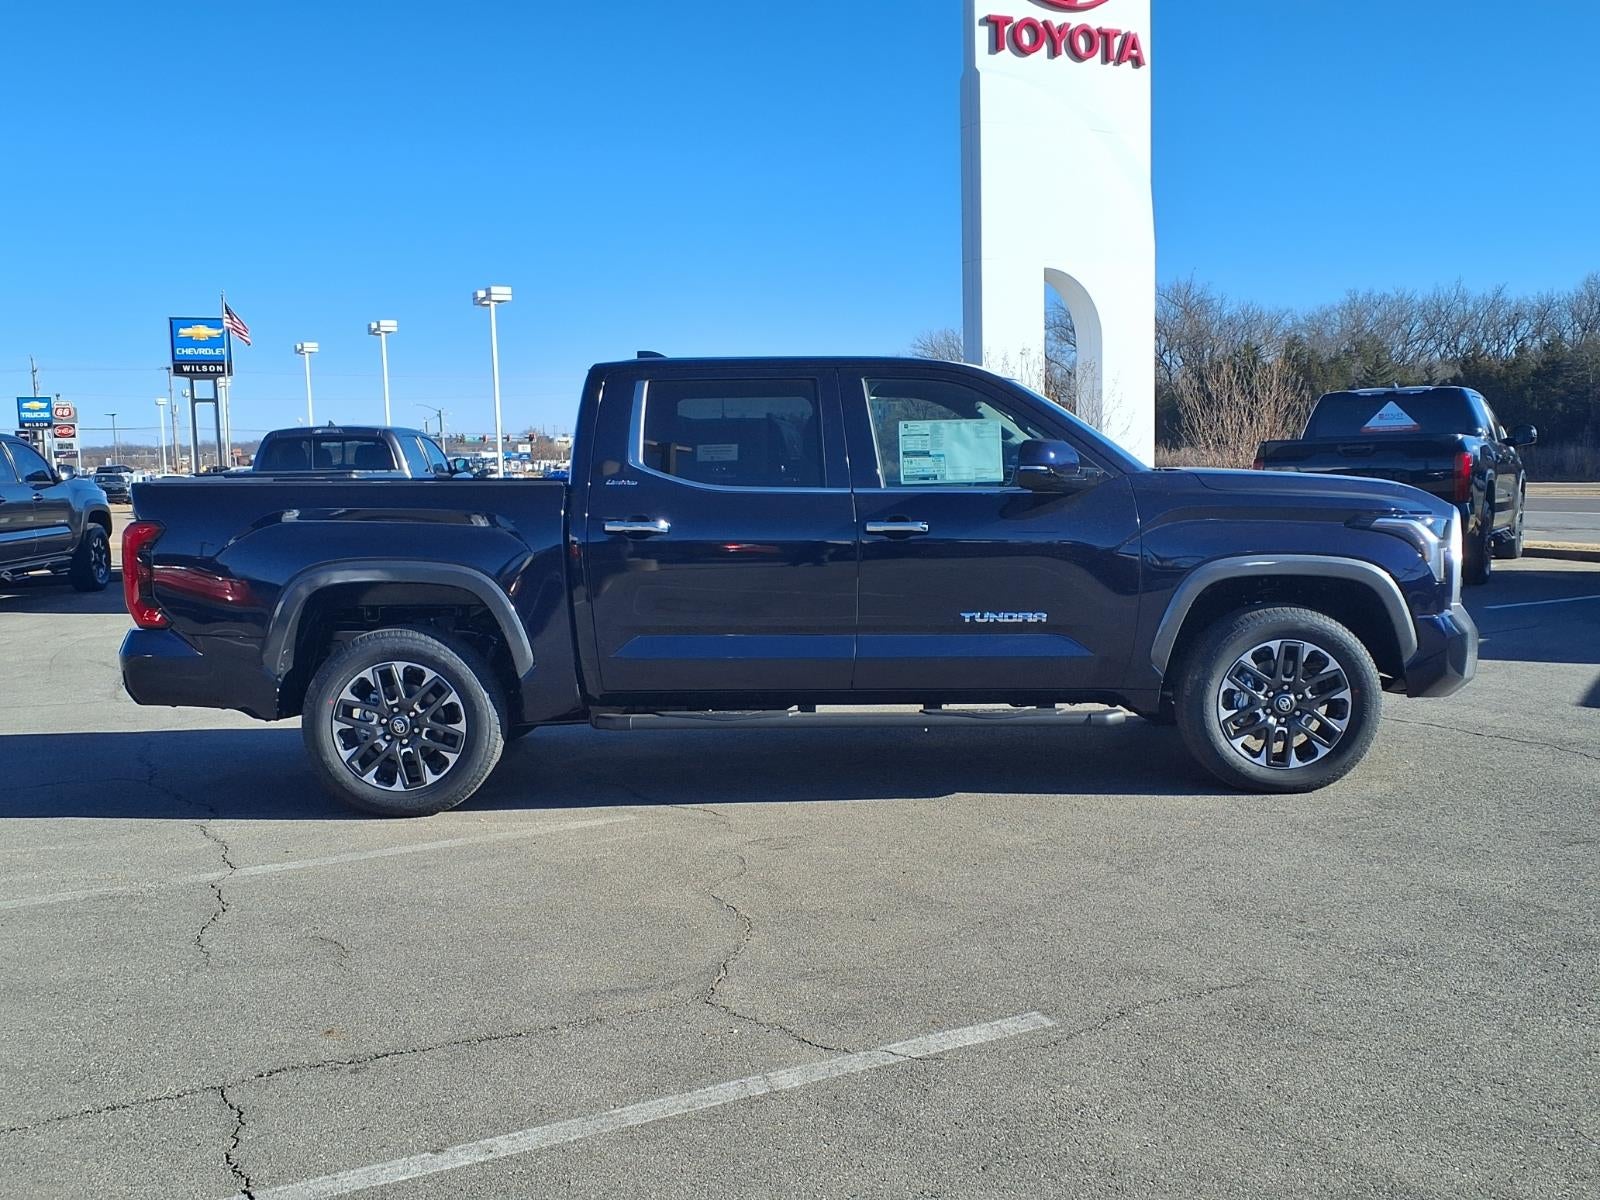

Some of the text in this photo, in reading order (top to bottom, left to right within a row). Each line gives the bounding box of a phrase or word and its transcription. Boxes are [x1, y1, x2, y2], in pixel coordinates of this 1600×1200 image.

[979, 14, 1146, 69] TOYOTA
[176, 347, 225, 356] CHEVROLET
[182, 364, 223, 372] WILSON
[56, 408, 70, 416] 66
[959, 611, 1048, 623] TUNDRA
